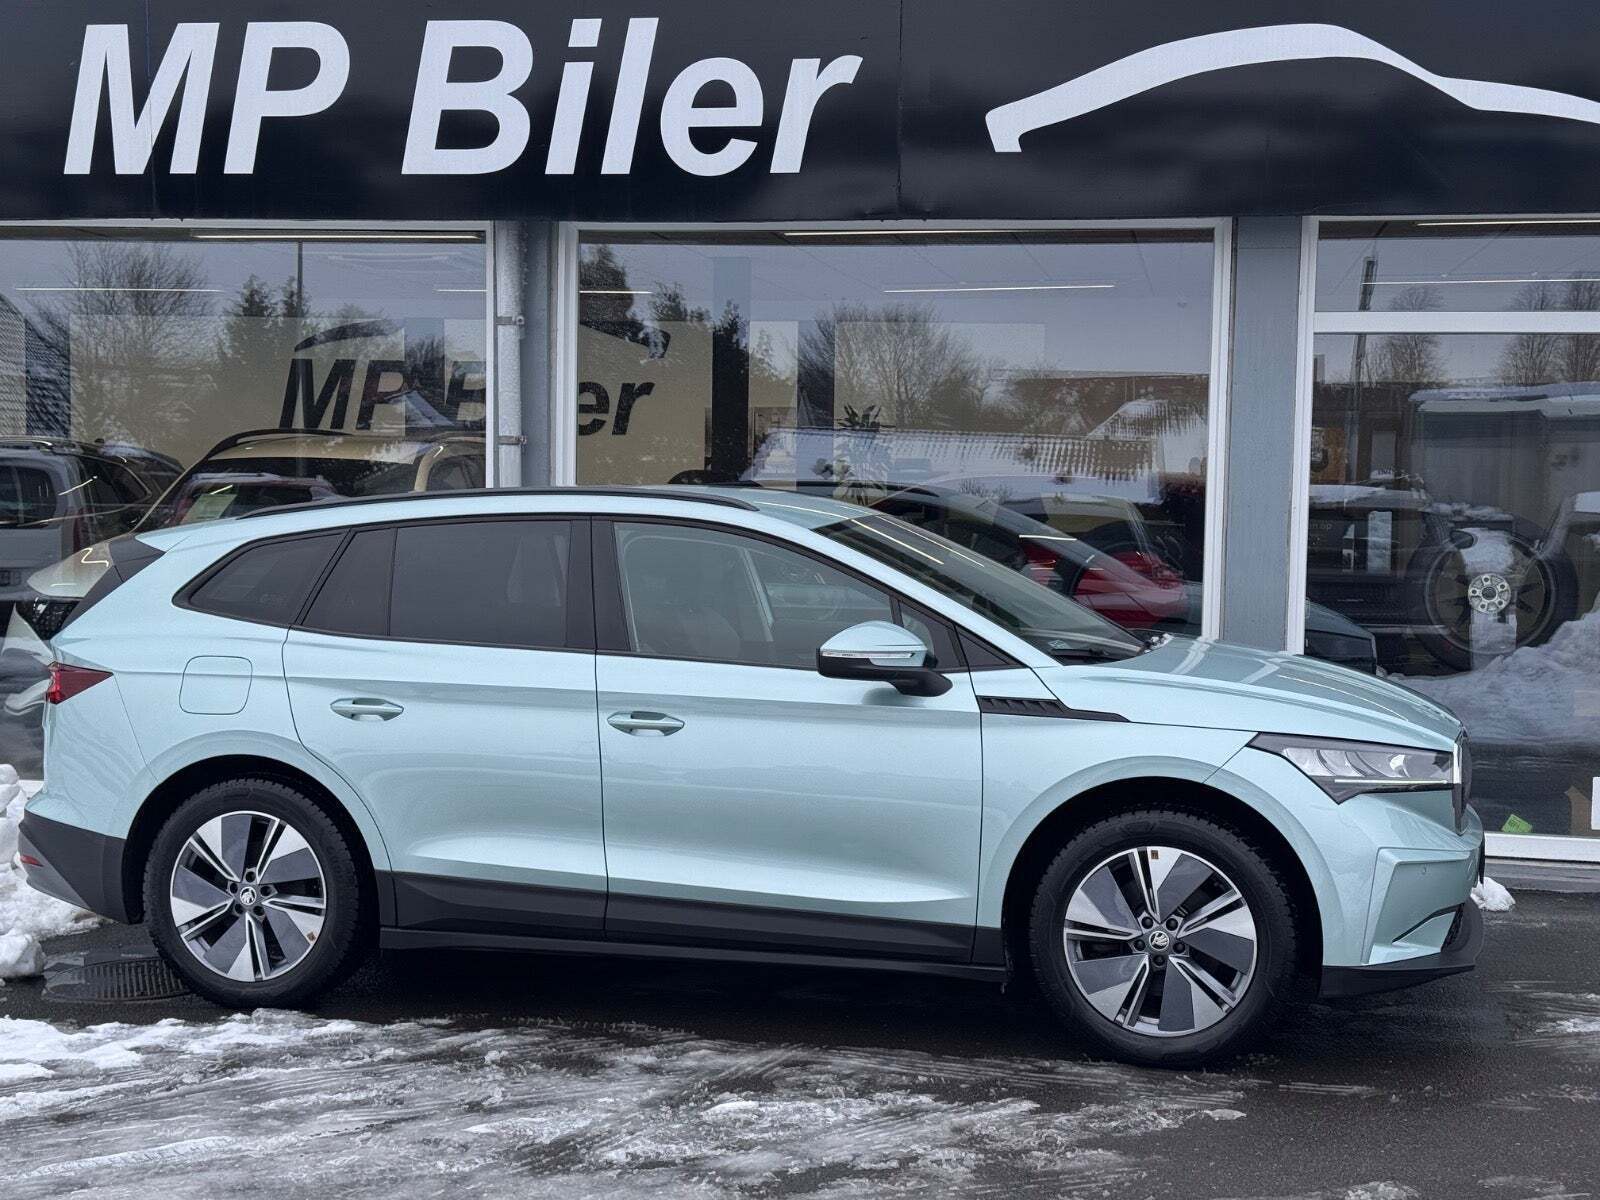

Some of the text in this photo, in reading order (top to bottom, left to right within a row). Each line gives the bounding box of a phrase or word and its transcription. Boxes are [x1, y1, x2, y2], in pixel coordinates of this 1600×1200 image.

[64, 17, 863, 177] MP Biler
[279, 358, 409, 430] MP
